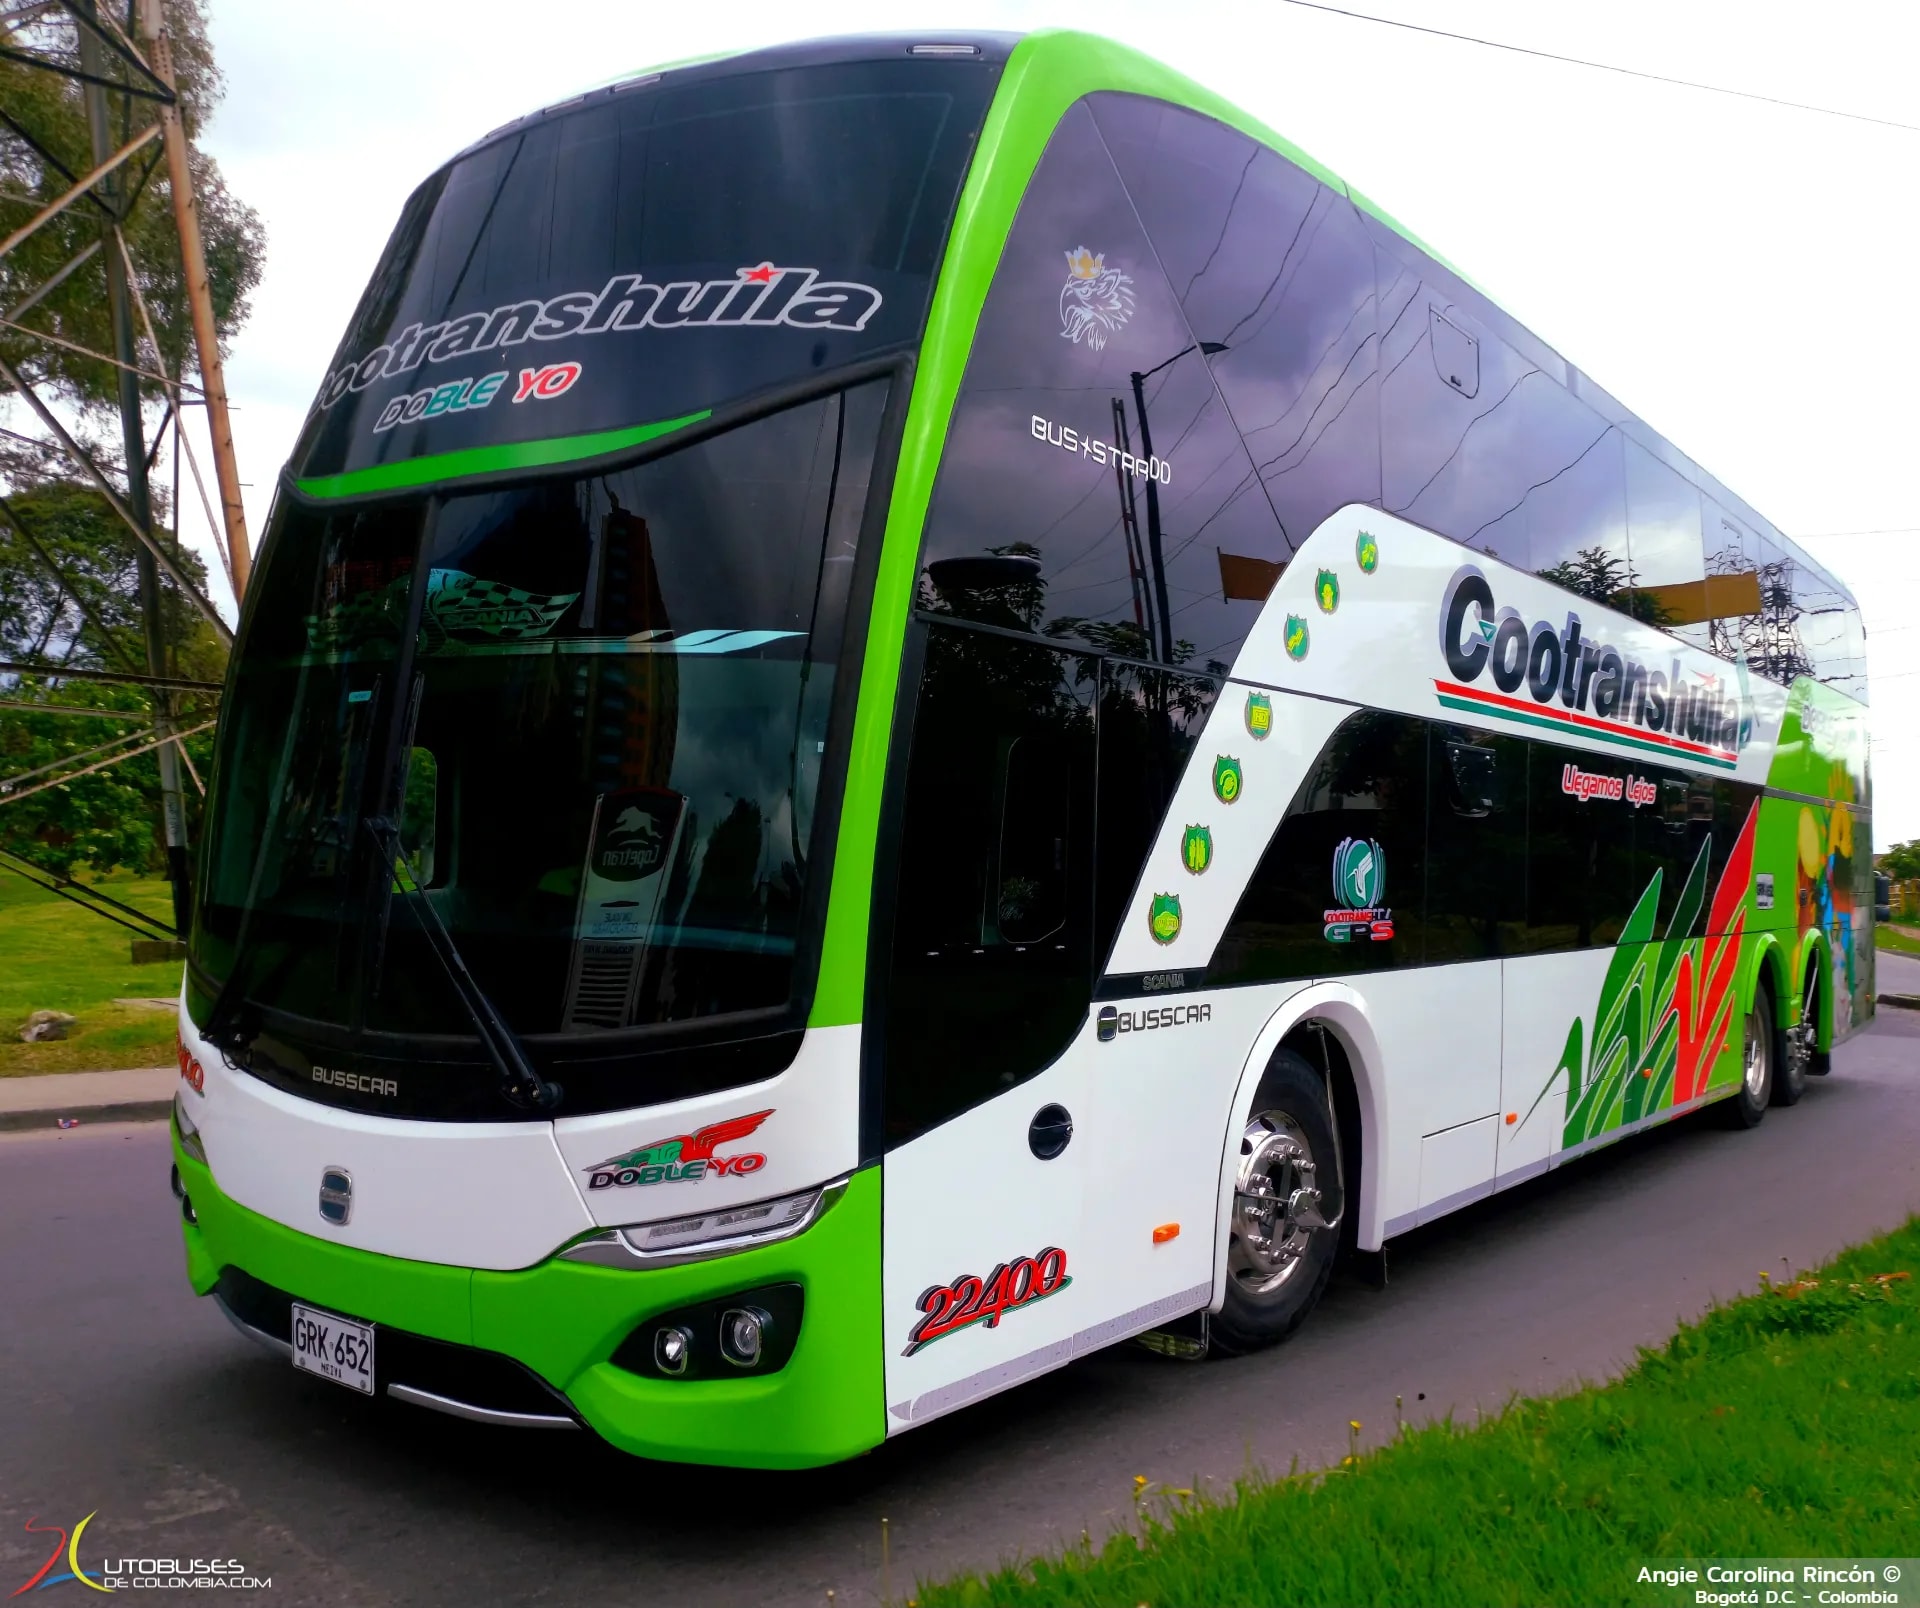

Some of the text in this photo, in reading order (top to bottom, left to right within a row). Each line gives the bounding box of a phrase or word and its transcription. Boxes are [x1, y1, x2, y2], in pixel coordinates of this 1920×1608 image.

[373, 362, 582, 433] DOBLE YO
[442, 609, 535, 626] SCANIA
[1439, 564, 1739, 752] Cootranshuila
[1562, 764, 1657, 808] Llegamos Lejos
[1324, 921, 1394, 943] GPS
[1142, 973, 1185, 991] SCANIA
[1117, 1003, 1211, 1034] BUSSCAR
[312, 1066, 398, 1097] BUSSCAR
[589, 1152, 768, 1191] DOBLE YO
[907, 1246, 1067, 1342] 22400
[295, 1317, 369, 1376] GRK 652
